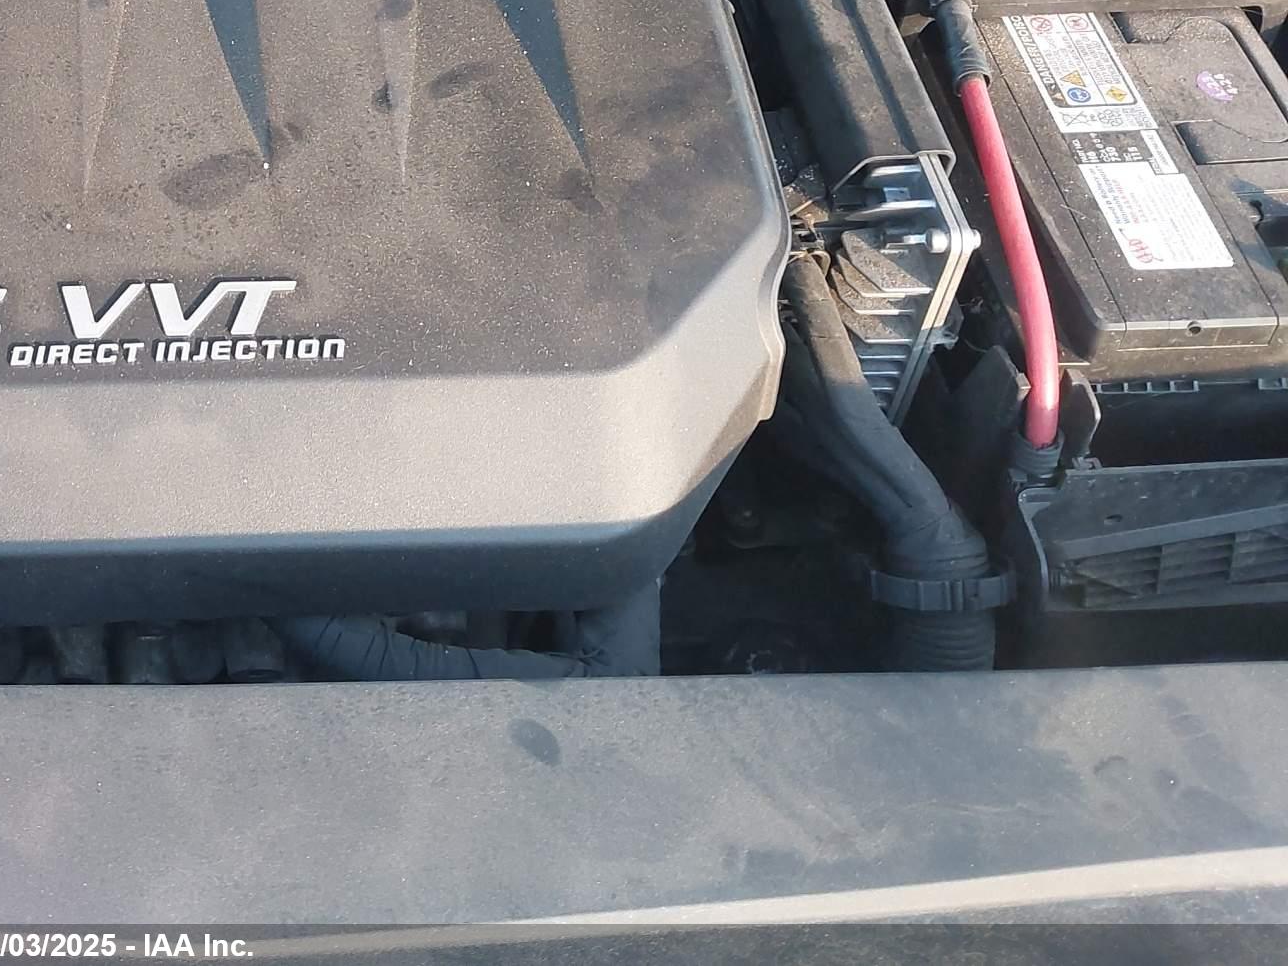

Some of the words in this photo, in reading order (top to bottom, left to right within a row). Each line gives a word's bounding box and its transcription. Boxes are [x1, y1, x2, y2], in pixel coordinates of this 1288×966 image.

[59, 280, 297, 339] VVT
[10, 340, 145, 367] DIRECT
[155, 338, 346, 362] INJECTION
